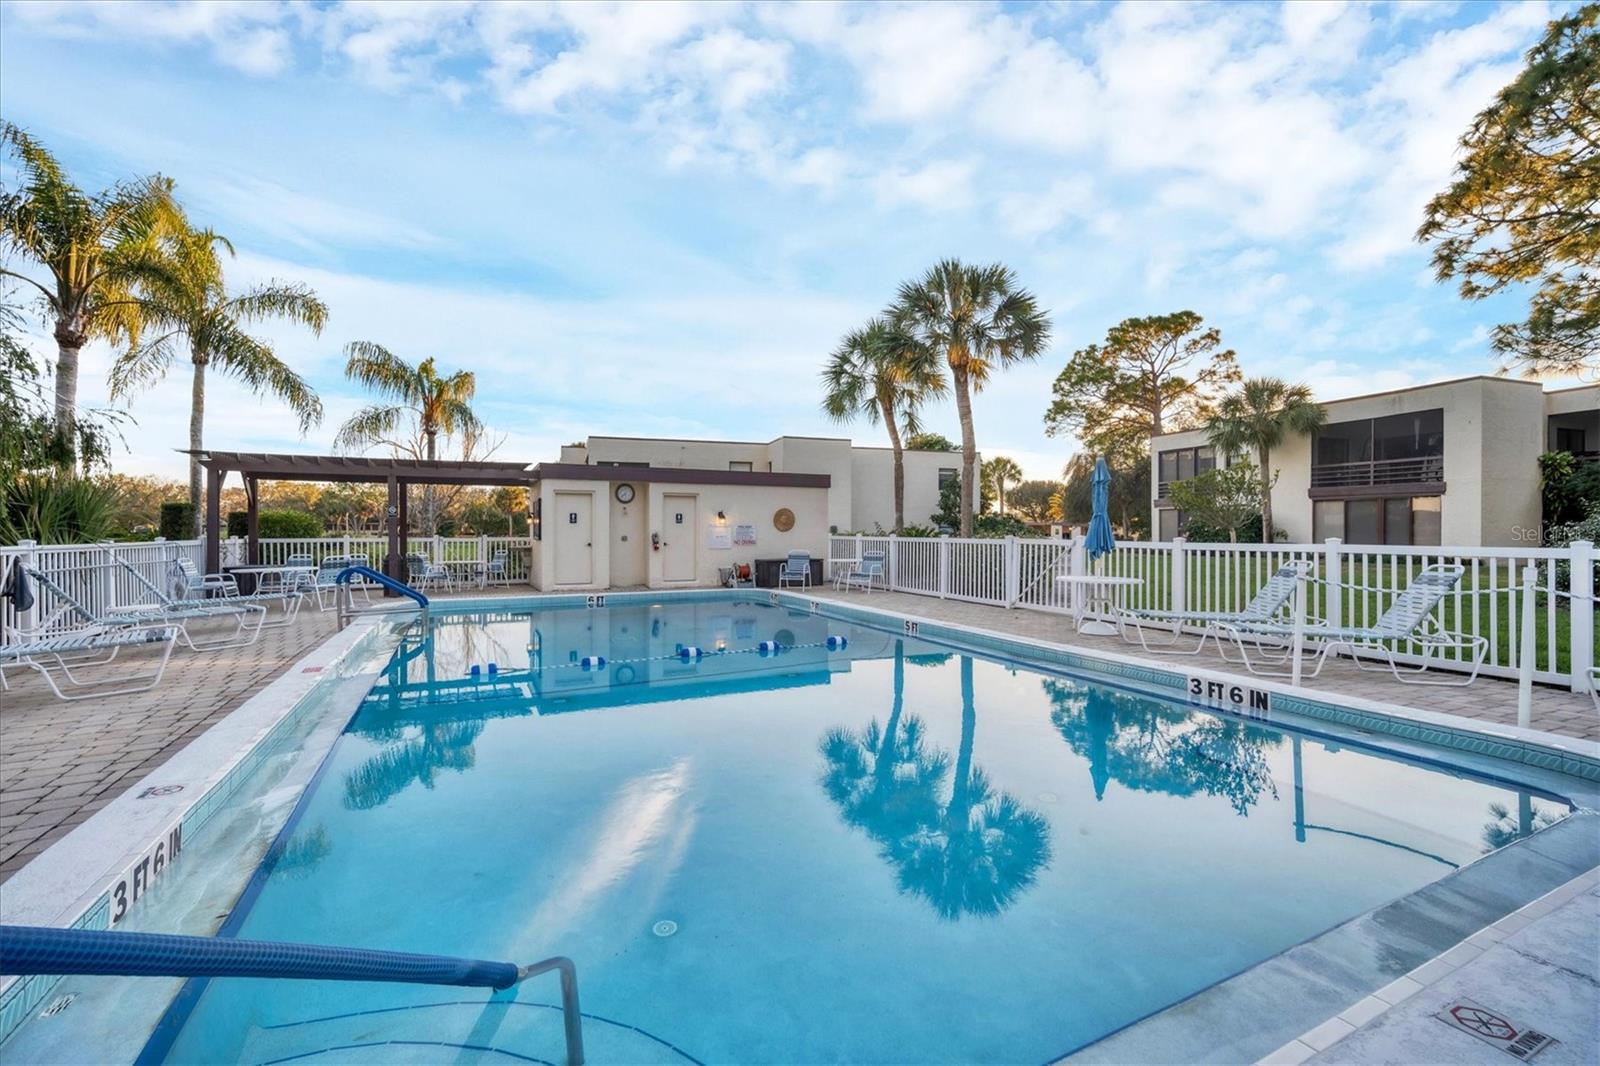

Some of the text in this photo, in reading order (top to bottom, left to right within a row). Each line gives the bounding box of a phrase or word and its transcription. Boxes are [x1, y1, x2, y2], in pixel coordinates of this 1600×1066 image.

[905, 620, 911, 631] 5
[1190, 678, 1269, 711] 3 FT 6 IN
[113, 822, 182, 923] 3 FT 6 IN
[1505, 1030, 1548, 1058] NO DIVING
